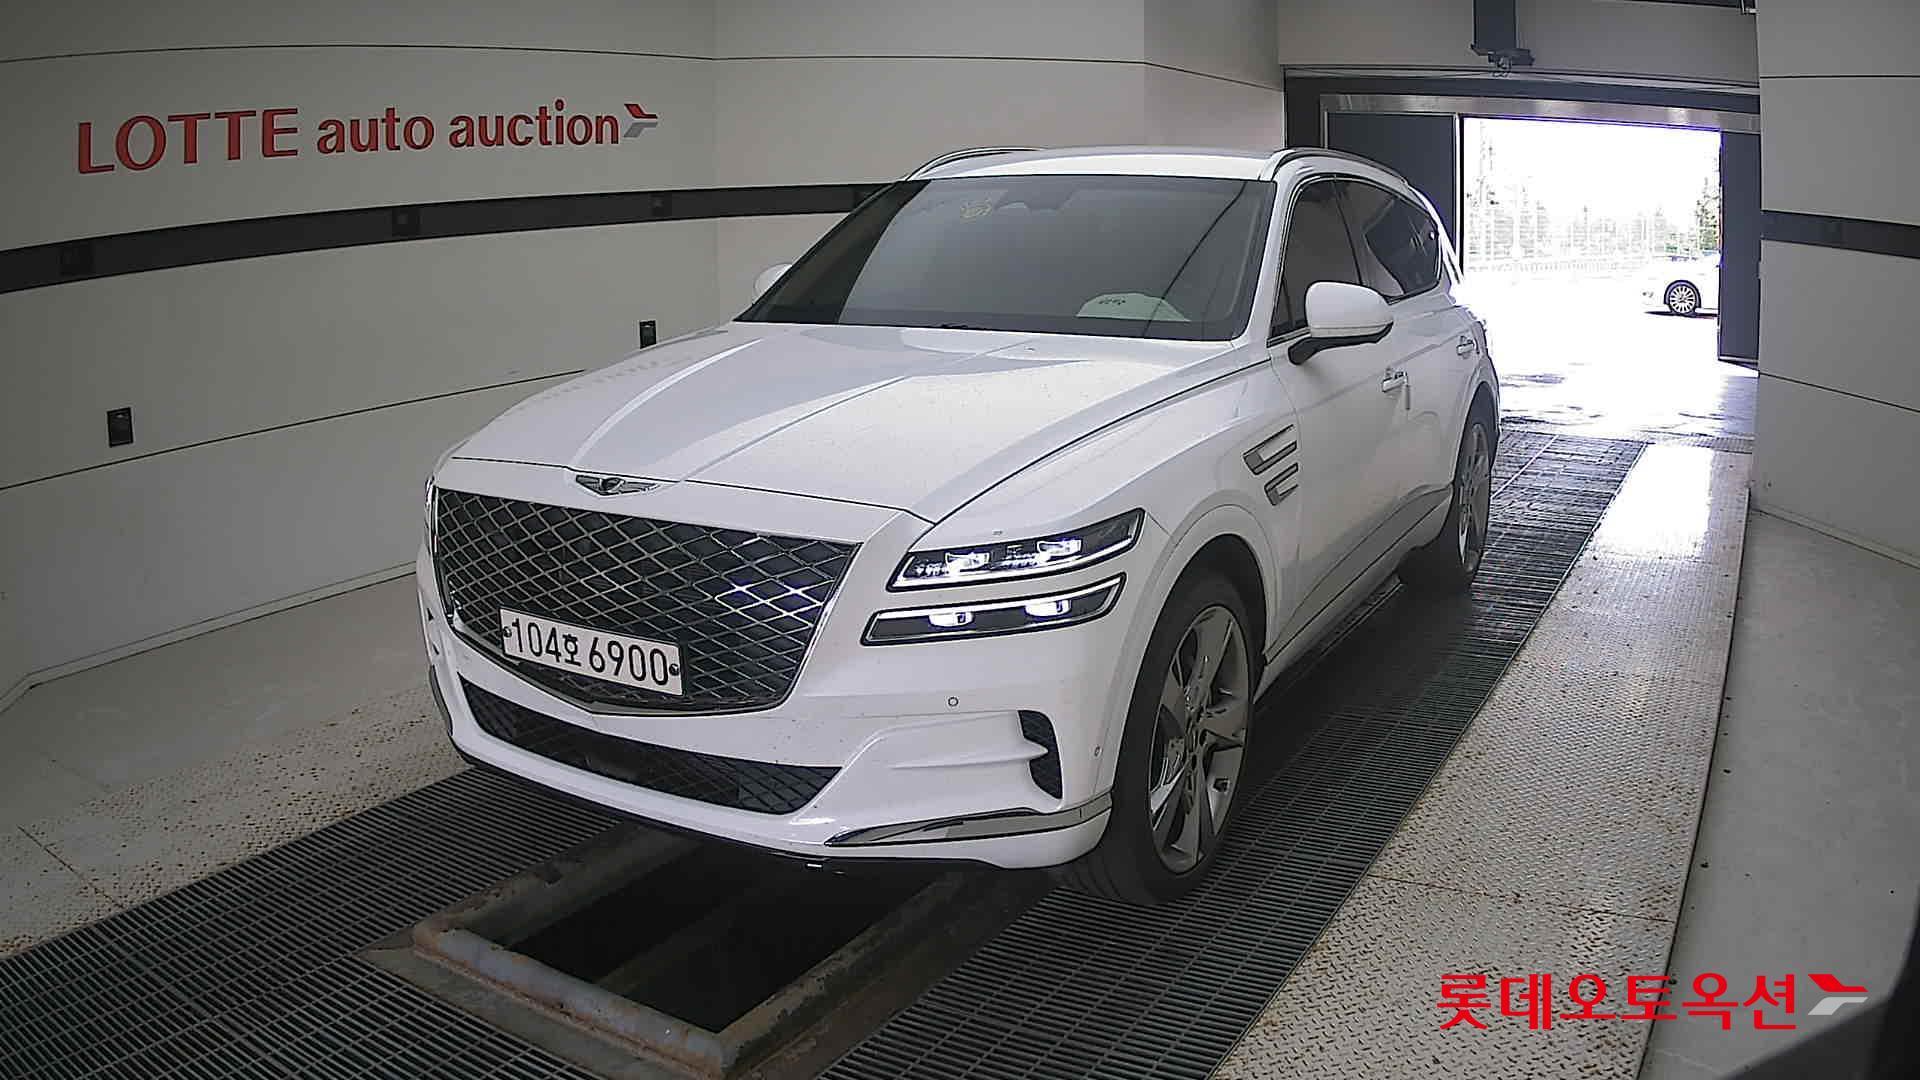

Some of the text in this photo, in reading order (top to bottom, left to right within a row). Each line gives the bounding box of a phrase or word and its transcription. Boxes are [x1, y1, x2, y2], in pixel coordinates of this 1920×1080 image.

[77, 98, 620, 174] LOTTE auto auction
[511, 617, 670, 686] 104호 6900
